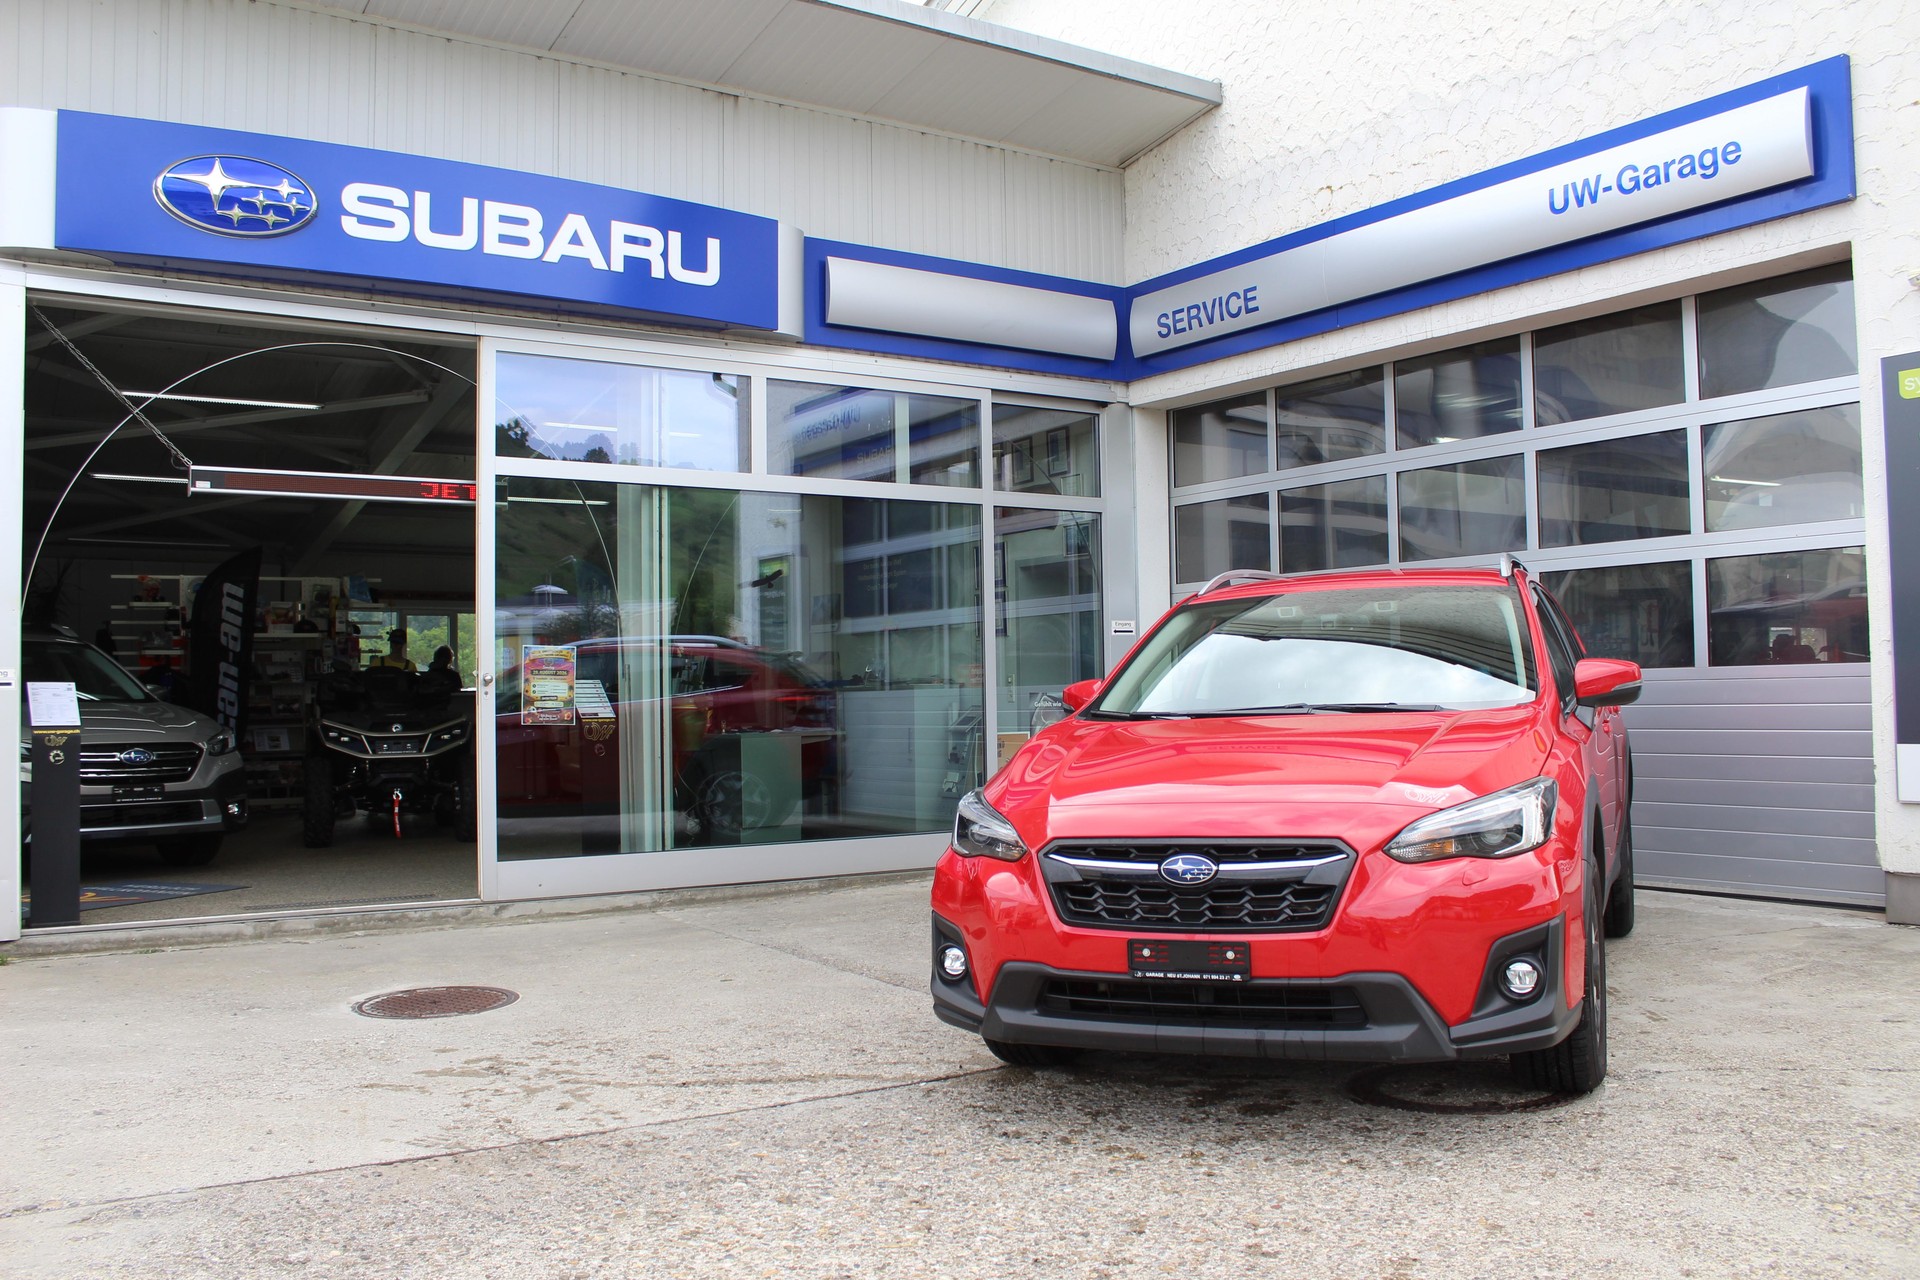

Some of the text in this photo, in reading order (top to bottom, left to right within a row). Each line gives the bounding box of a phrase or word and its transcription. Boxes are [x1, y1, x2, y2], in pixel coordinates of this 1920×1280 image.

[1547, 137, 1743, 216] UW-Garage
[340, 182, 721, 287] SUBARU
[1156, 285, 1260, 340] SERVICE
